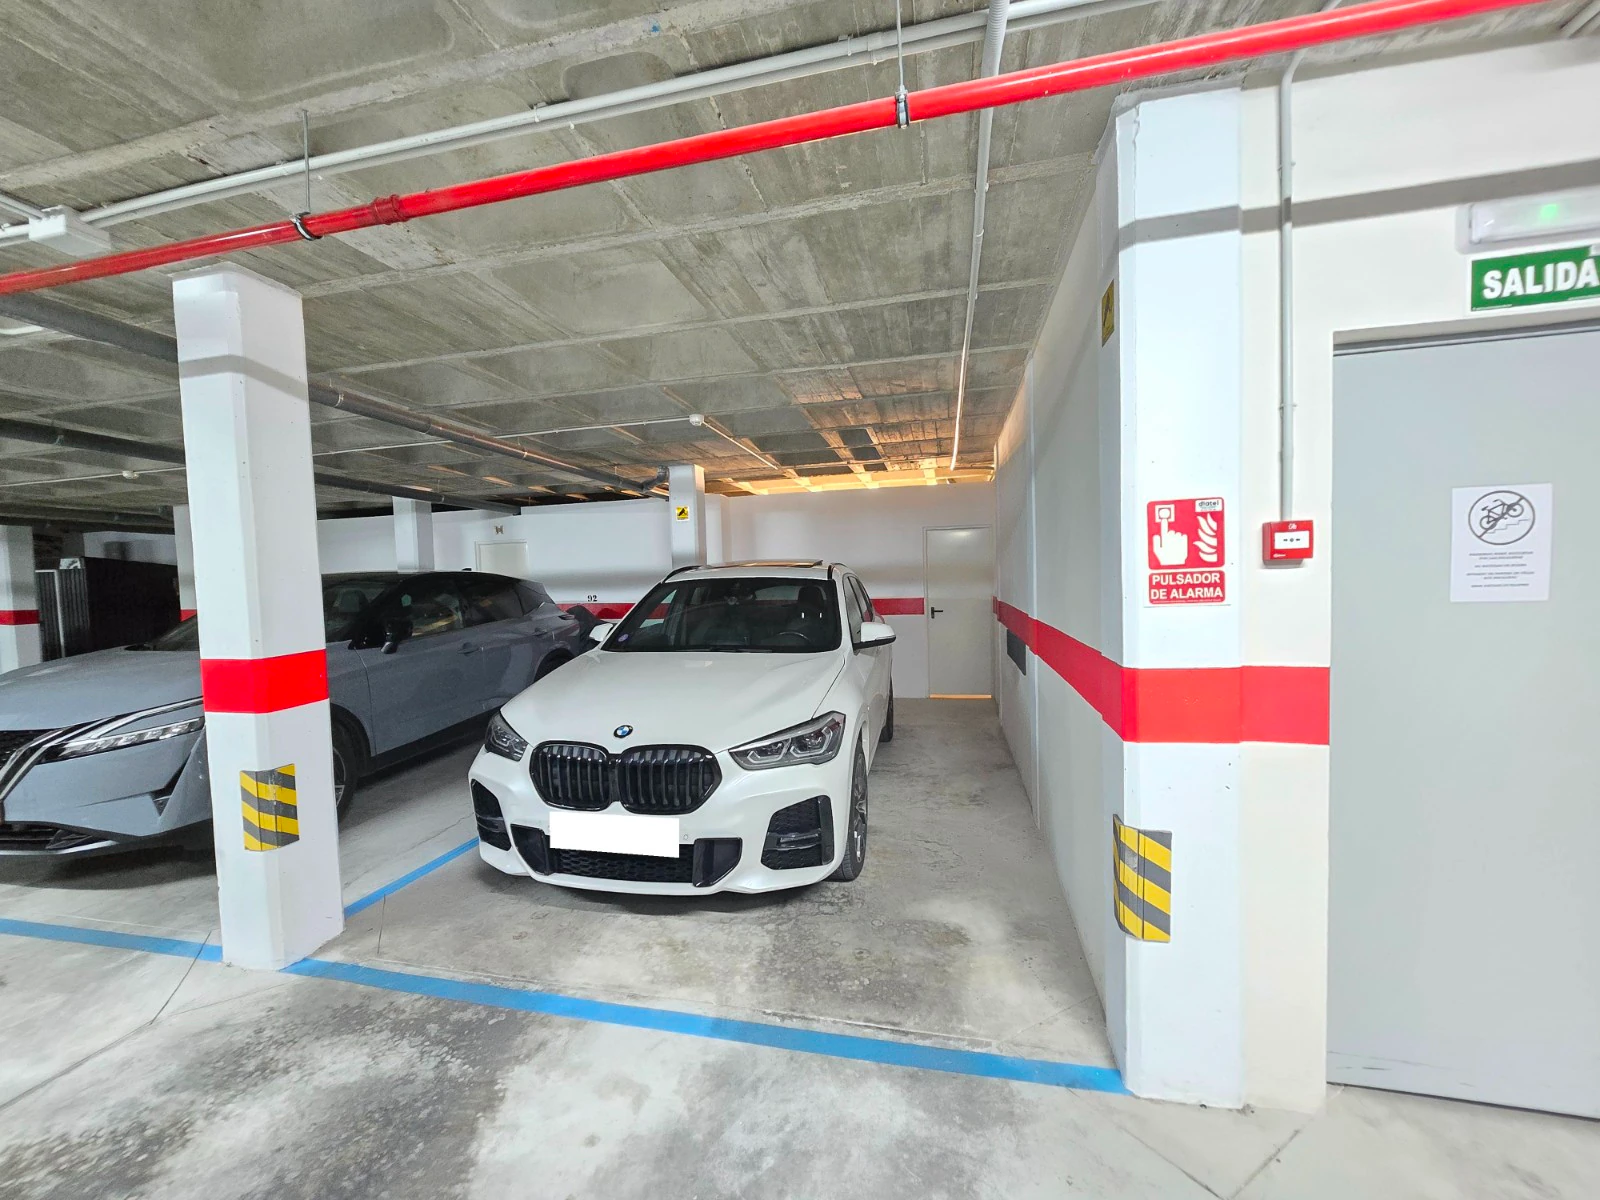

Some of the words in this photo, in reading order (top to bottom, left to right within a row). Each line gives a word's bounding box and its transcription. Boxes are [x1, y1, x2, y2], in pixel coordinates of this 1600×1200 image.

[1483, 258, 1600, 299] SALIDA
[1152, 573, 1220, 585] PULSADOR
[1150, 588, 1167, 599] DE
[1170, 587, 1223, 599] ALARMA
